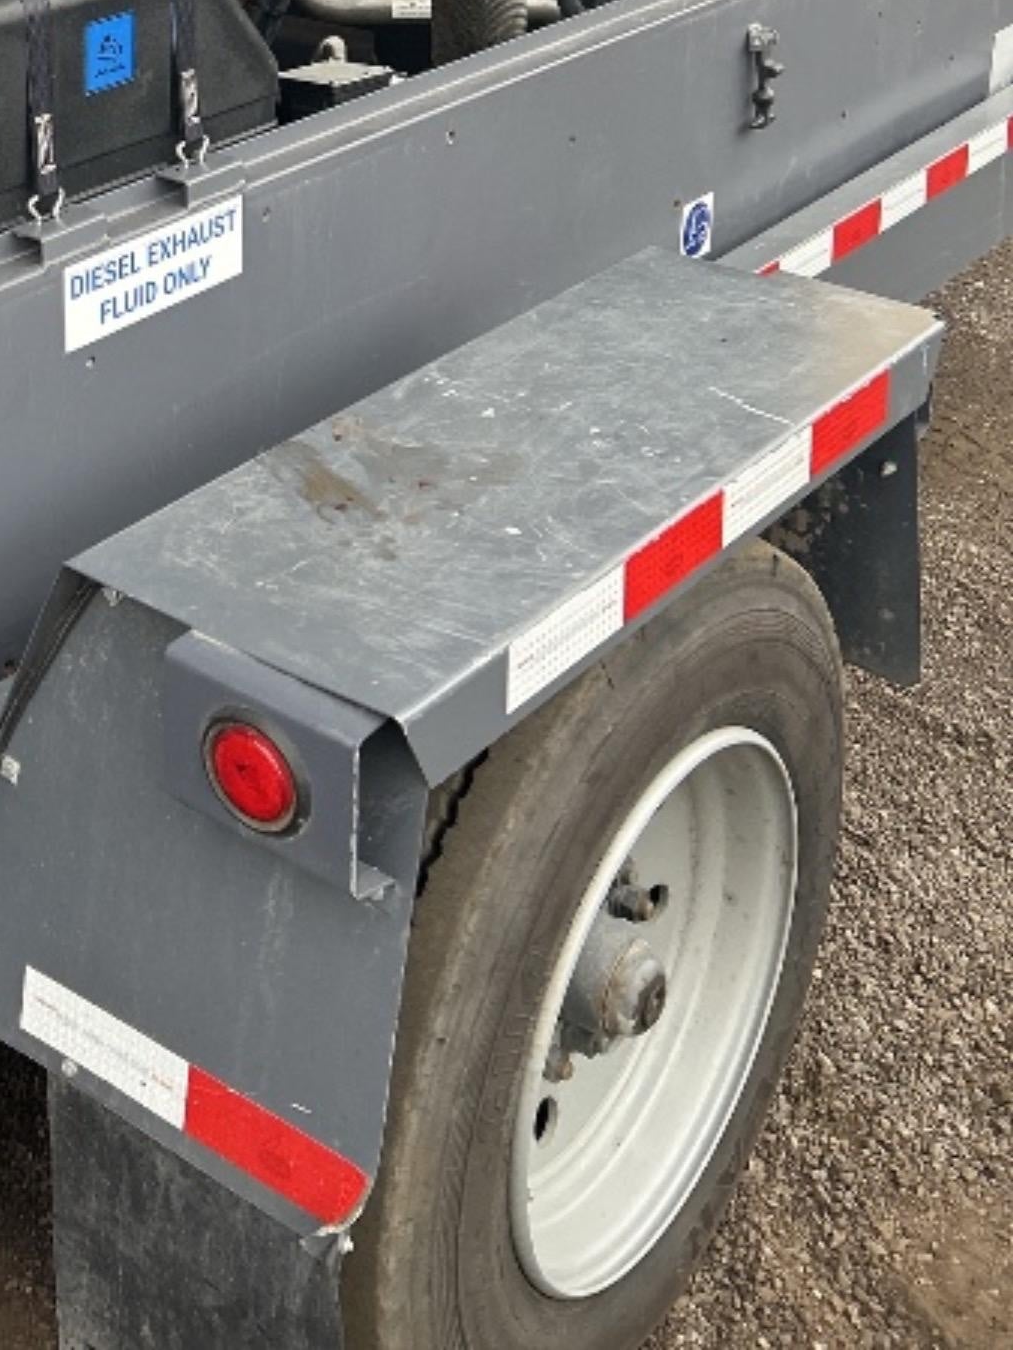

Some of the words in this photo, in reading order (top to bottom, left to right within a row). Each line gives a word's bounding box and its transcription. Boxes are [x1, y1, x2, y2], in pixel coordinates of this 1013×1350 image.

[70, 251, 141, 300] DIESEL
[148, 209, 237, 268] EXHAUST
[100, 281, 157, 325] FLUID
[163, 254, 213, 296] ONLY
